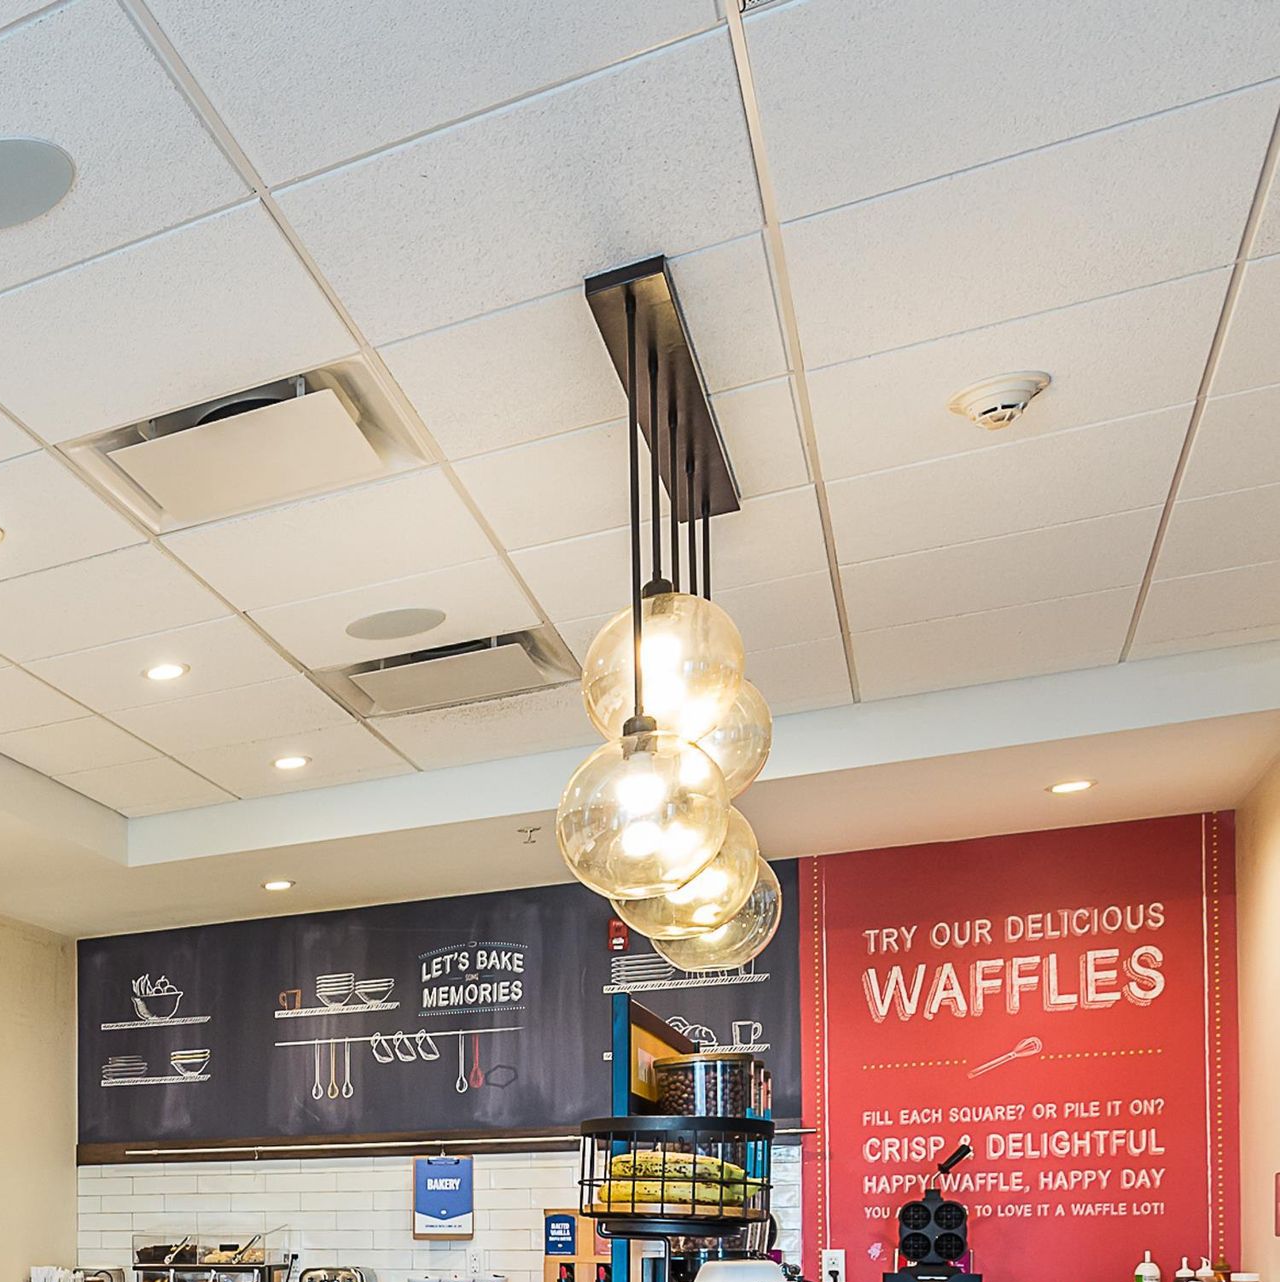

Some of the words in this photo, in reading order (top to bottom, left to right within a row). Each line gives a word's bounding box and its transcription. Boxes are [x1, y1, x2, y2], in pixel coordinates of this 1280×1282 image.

[864, 925, 918, 955] TRY
[930, 919, 993, 949] OUR
[1005, 902, 1165, 943] DELICIOUS
[421, 951, 470, 982] LET'S
[476, 950, 525, 973] BAKE
[422, 980, 523, 1008] MEMORIES
[861, 944, 1166, 1024] WAFFLES
[863, 1111, 893, 1127] FILL
[899, 1108, 942, 1125] EACH
[949, 1104, 1026, 1123] SQUARE?
[1032, 1103, 1057, 1119] OR
[1064, 1101, 1100, 1118] PILE
[1106, 1101, 1122, 1117] IT
[1129, 1098, 1165, 1116] ON?
[863, 1136, 945, 1163] CRISP
[986, 1128, 1165, 1161] DELIGHTFUL
[426, 1178, 461, 1190] BAKERY
[863, 1174, 931, 1194] HAPPY
[940, 1171, 1031, 1194] WAFFLE,
[1039, 1169, 1111, 1191] HAPPY
[1121, 1168, 1165, 1189] DAY
[864, 1206, 891, 1219] YOU
[975, 1204, 993, 1217] TO
[997, 1204, 1032, 1217] LOVE
[1037, 1204, 1050, 1216] IT
[1055, 1204, 1065, 1216] A
[1071, 1203, 1127, 1217] WAFFLE
[1132, 1203, 1165, 1216] LOT!
